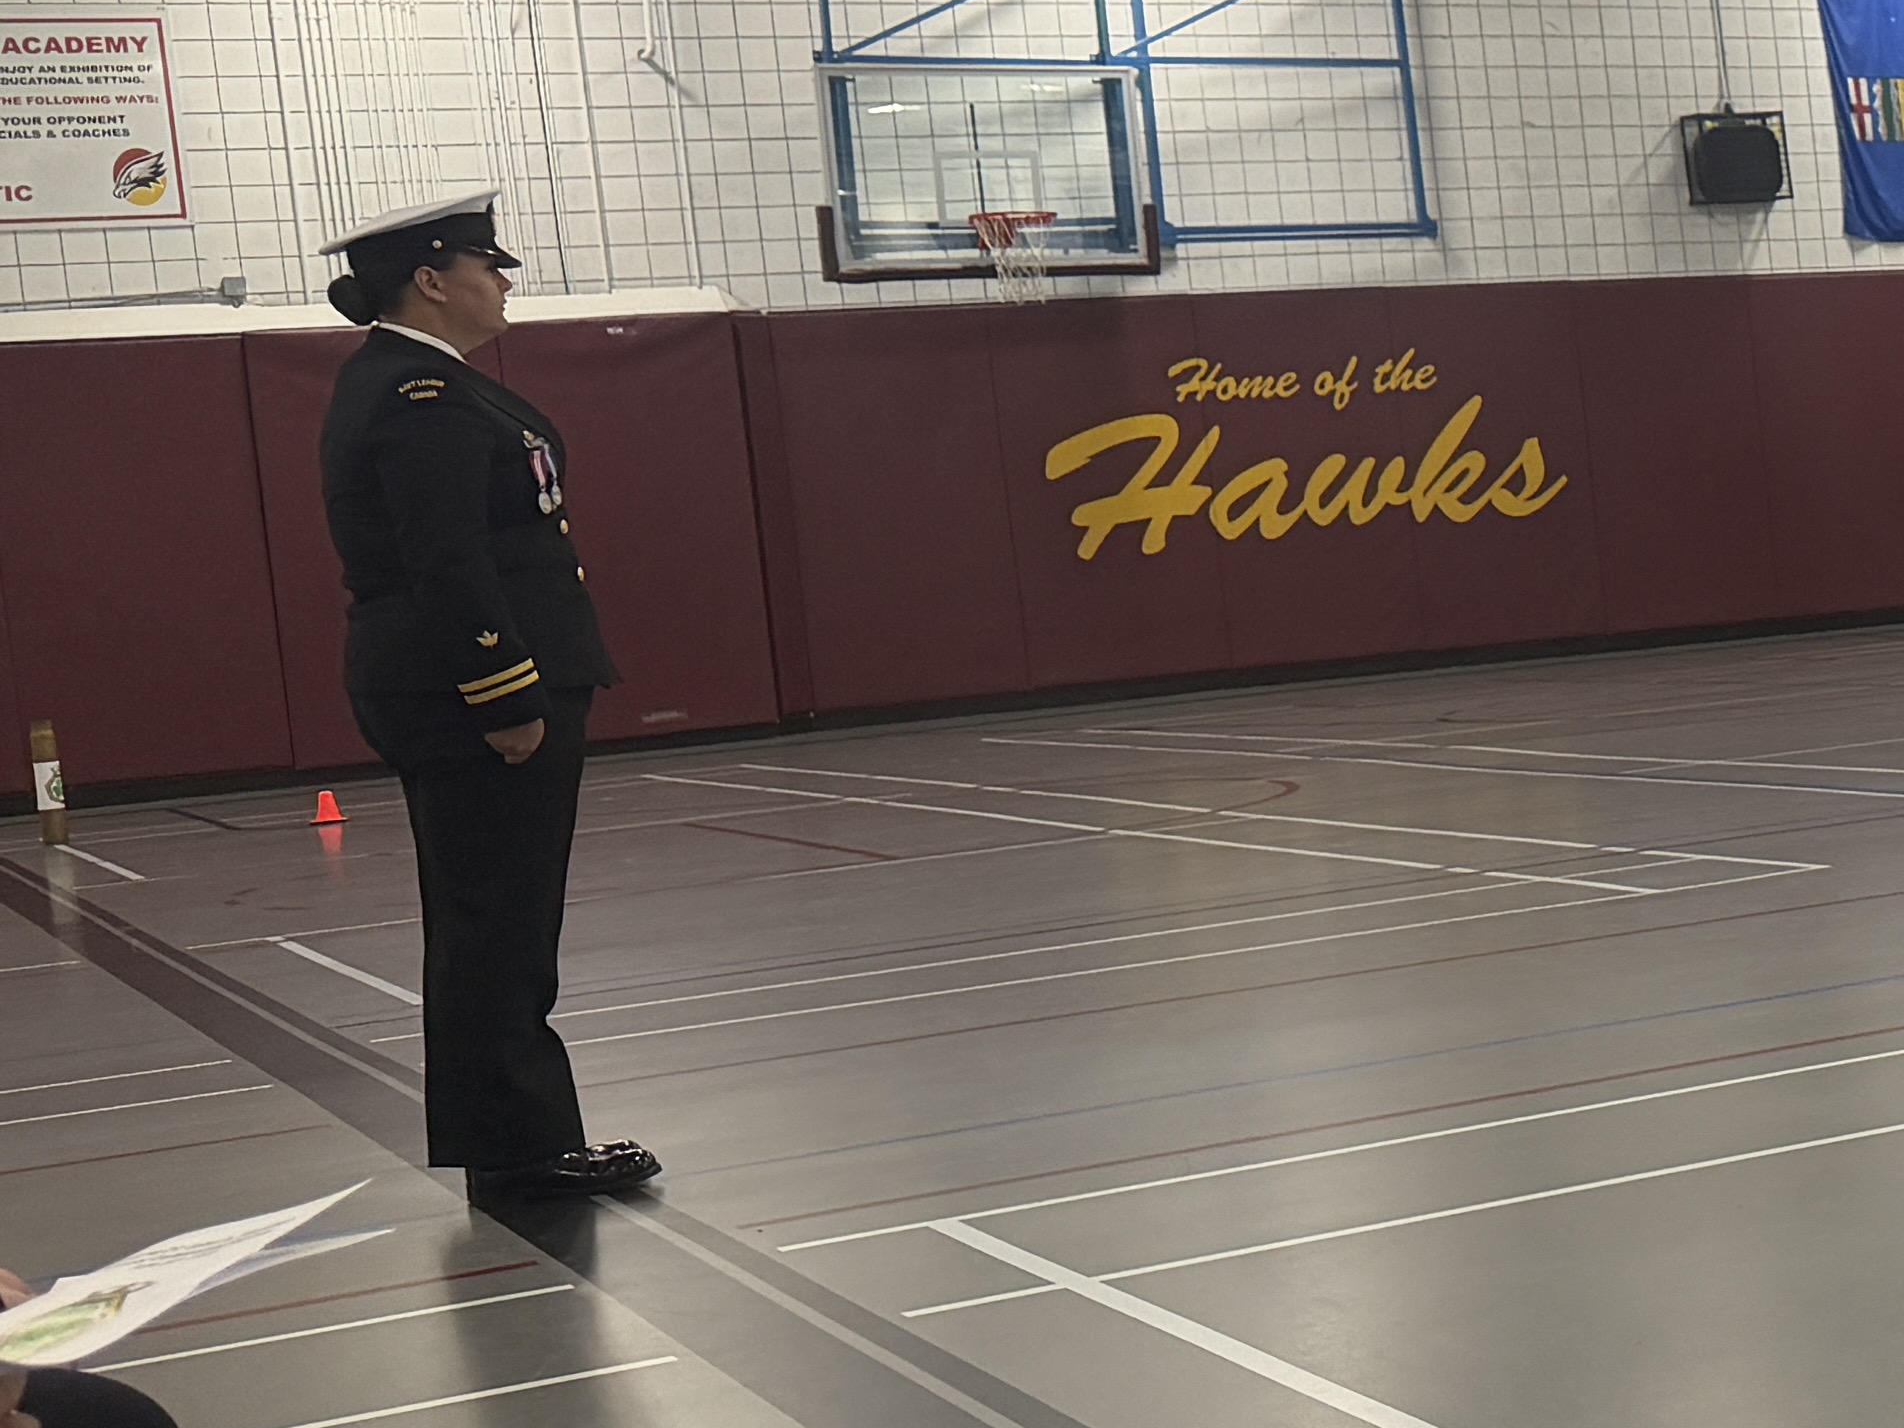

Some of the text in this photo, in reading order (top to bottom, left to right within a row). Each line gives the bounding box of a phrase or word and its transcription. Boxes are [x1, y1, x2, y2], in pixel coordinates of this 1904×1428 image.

[1, 36, 148, 54] ACADEMY
[60, 64, 134, 74] EXHIBITION
[26, 95, 112, 106] FOLLOWING
[0, 114, 127, 127] YOUR OPPONENT
[61, 128, 131, 139] COACHES
[0, 184, 34, 203] IC
[1167, 347, 1438, 411] Home of the
[1044, 394, 1569, 561] Hawks
